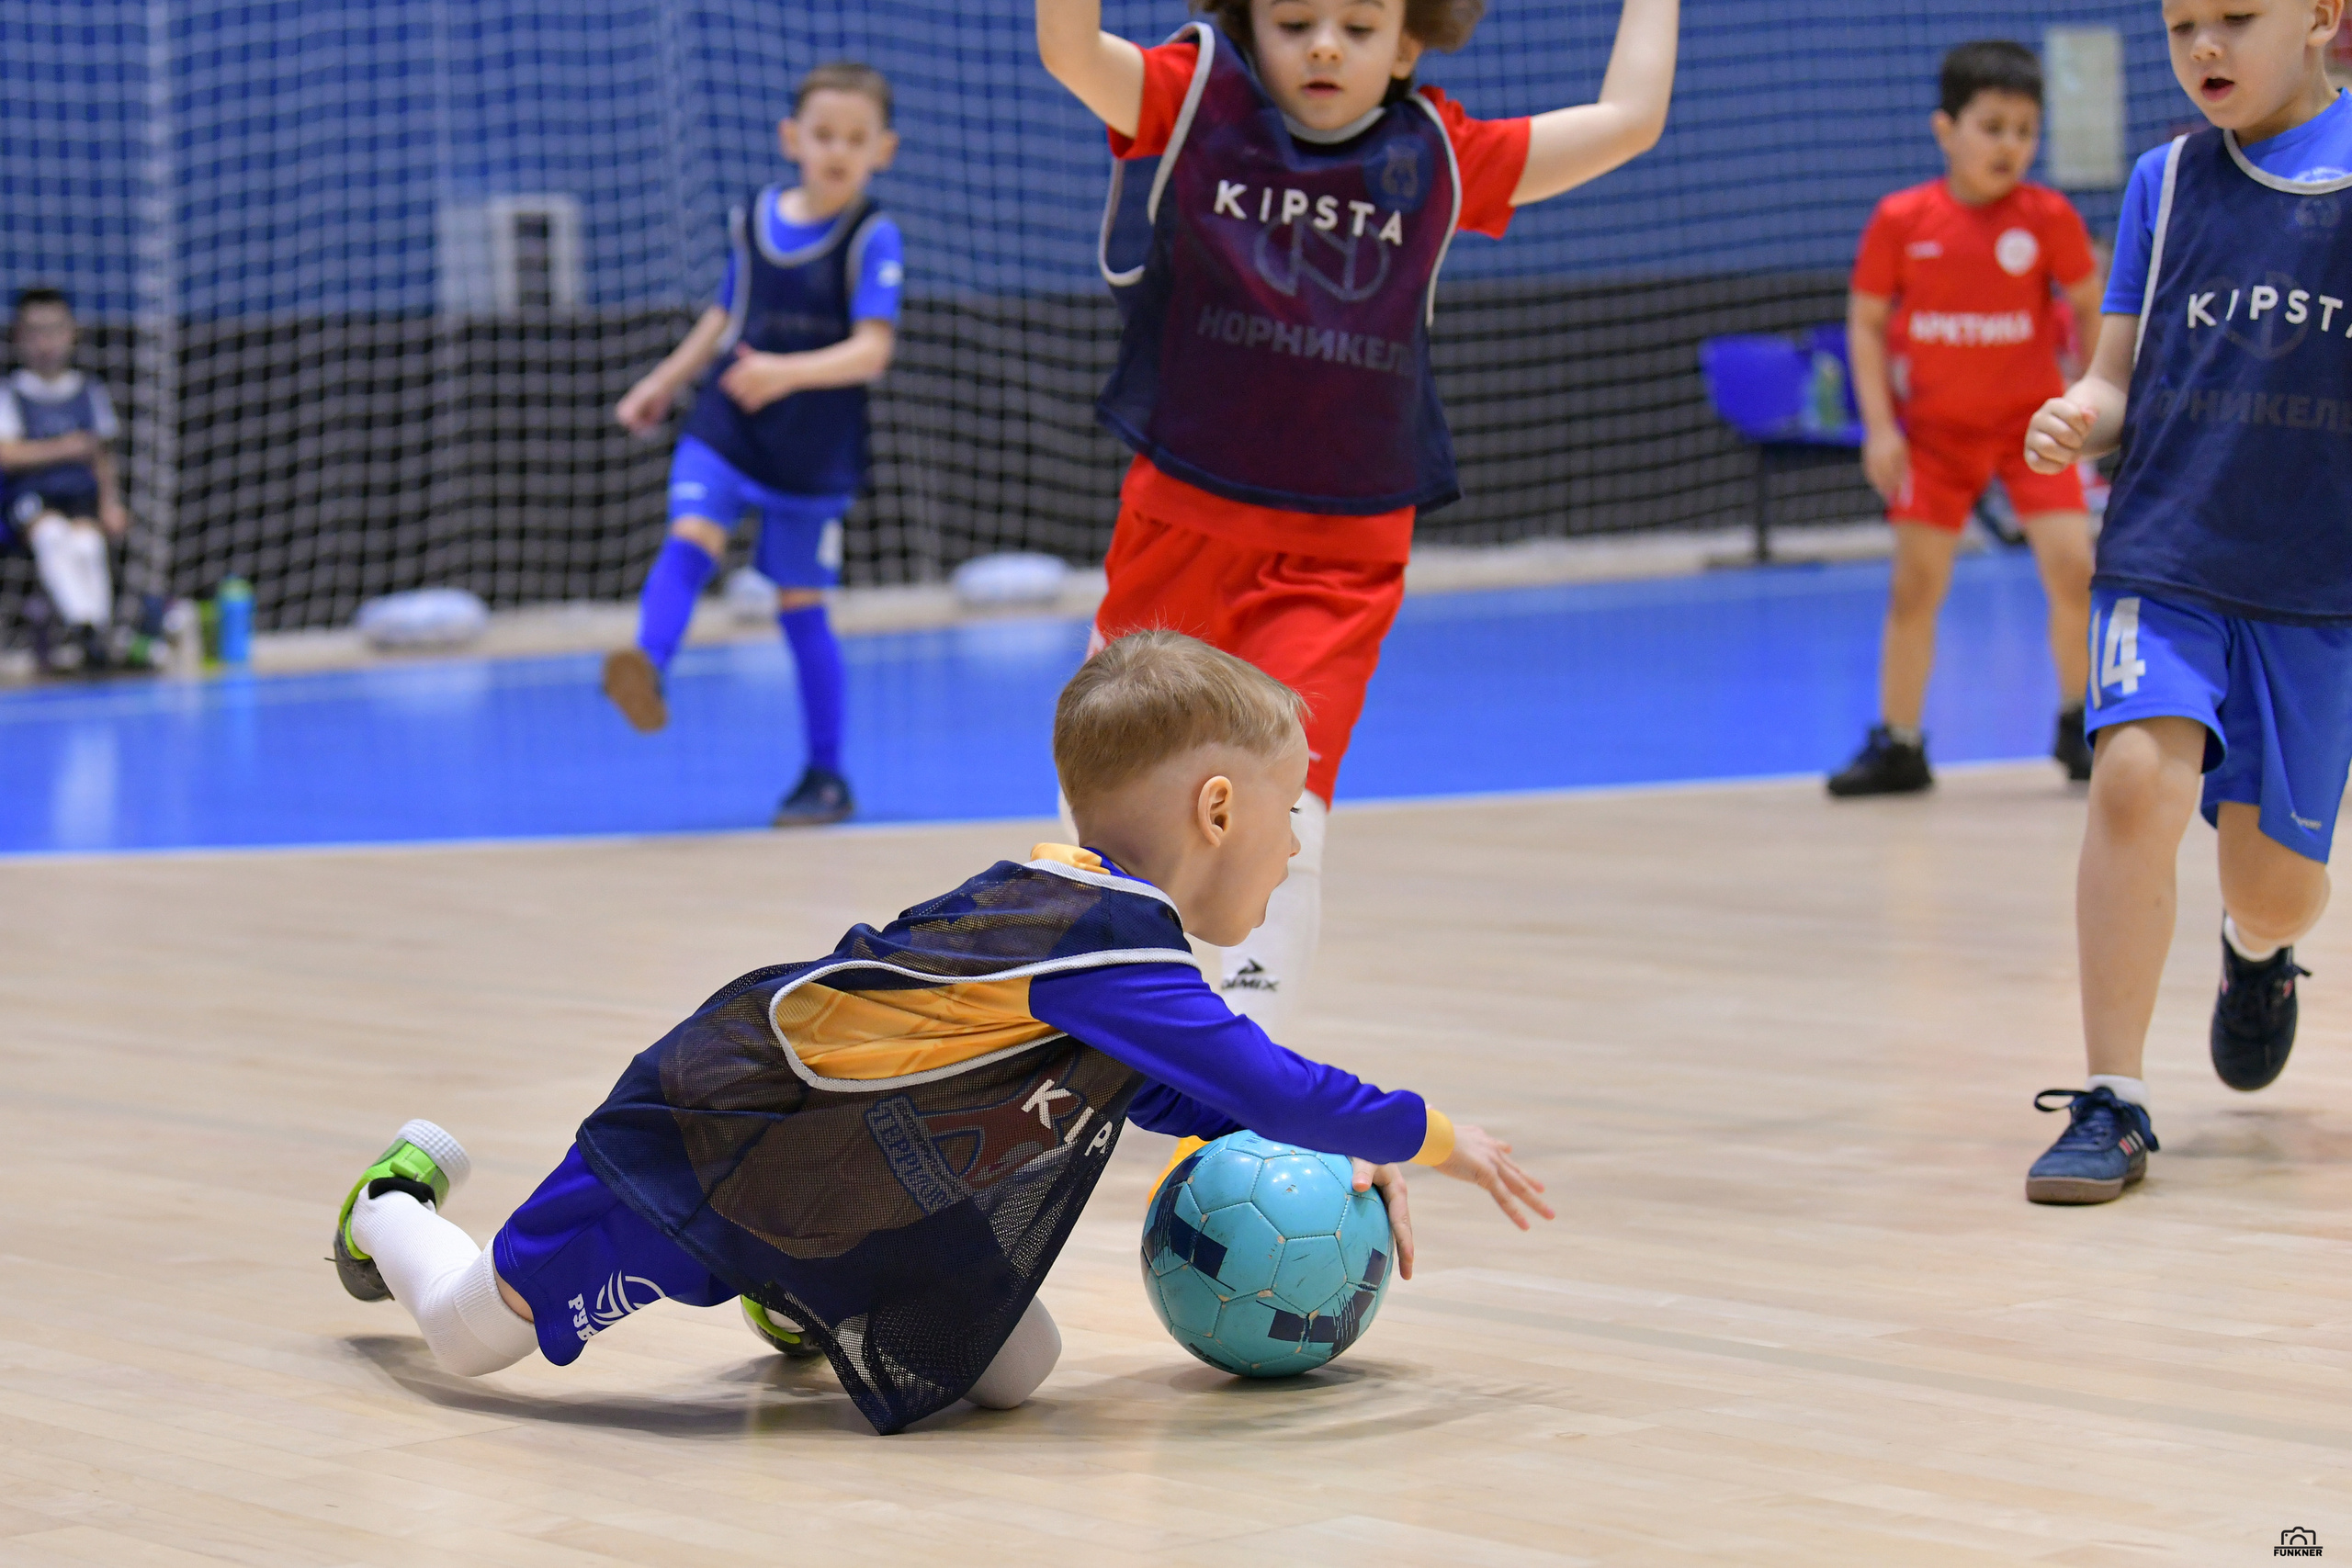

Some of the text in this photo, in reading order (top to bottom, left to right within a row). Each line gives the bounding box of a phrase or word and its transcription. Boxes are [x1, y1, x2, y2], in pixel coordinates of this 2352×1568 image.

[1214, 179, 1404, 246] KIPSTA
[1196, 304, 1416, 378] НОРНИКЕЛ
[2187, 285, 2352, 339] KIPST
[1020, 1078, 1114, 1157] KIP
